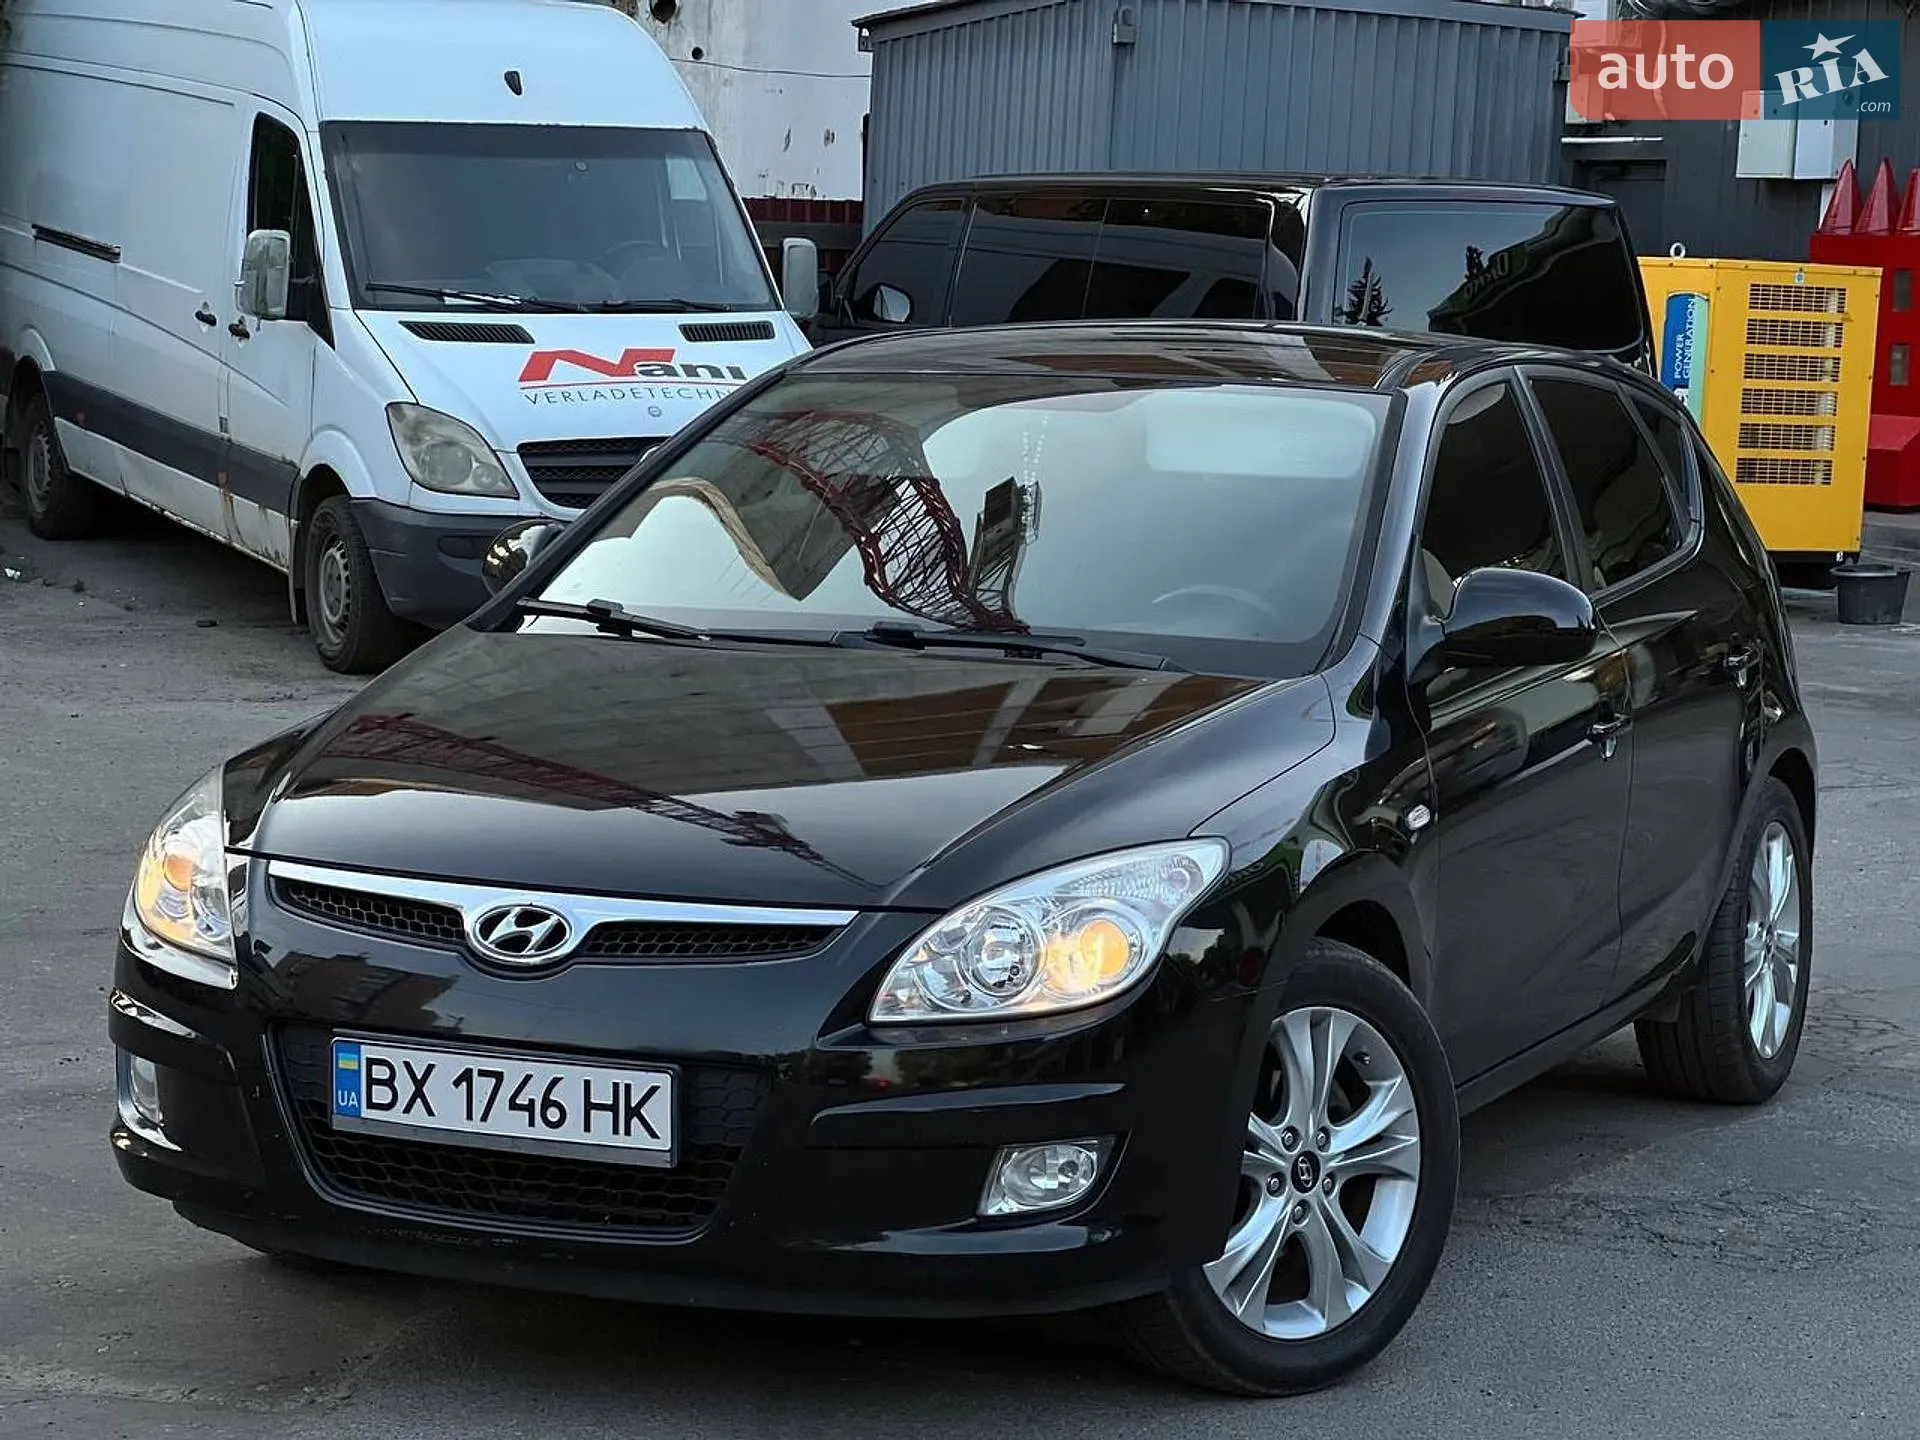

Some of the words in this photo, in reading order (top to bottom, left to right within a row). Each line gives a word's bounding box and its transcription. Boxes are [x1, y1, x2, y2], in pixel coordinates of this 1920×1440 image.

[1674, 334, 1685, 379] POWER
[1682, 298, 1695, 379] GENERATION
[518, 348, 747, 383] Nani
[337, 1090, 360, 1109] UA
[365, 1058, 436, 1118] BX
[452, 1067, 568, 1129] 1746
[583, 1078, 662, 1140] HK
